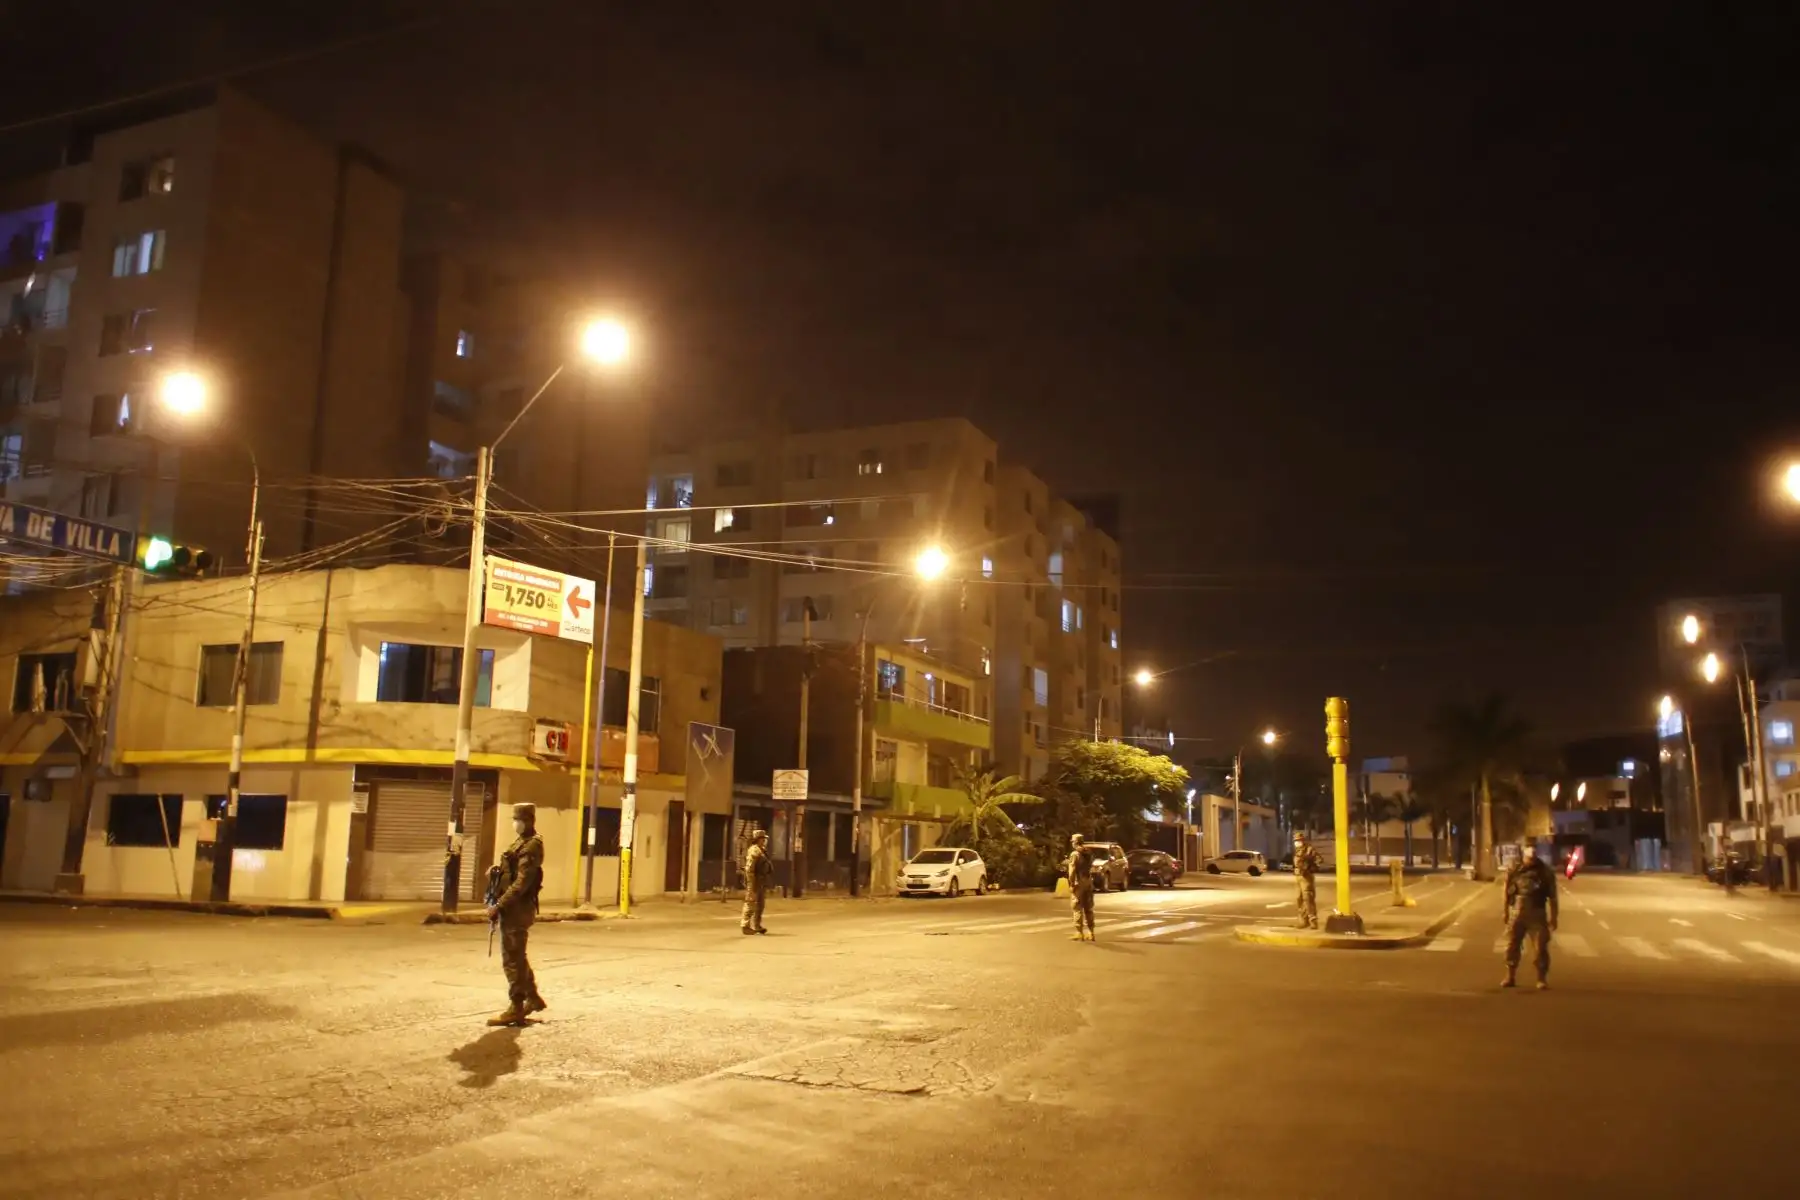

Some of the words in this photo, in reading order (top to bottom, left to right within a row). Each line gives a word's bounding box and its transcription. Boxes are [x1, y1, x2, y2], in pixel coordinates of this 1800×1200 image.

[27, 512, 56, 541] DE
[66, 521, 120, 557] VILLA
[505, 584, 545, 609] 1,750
